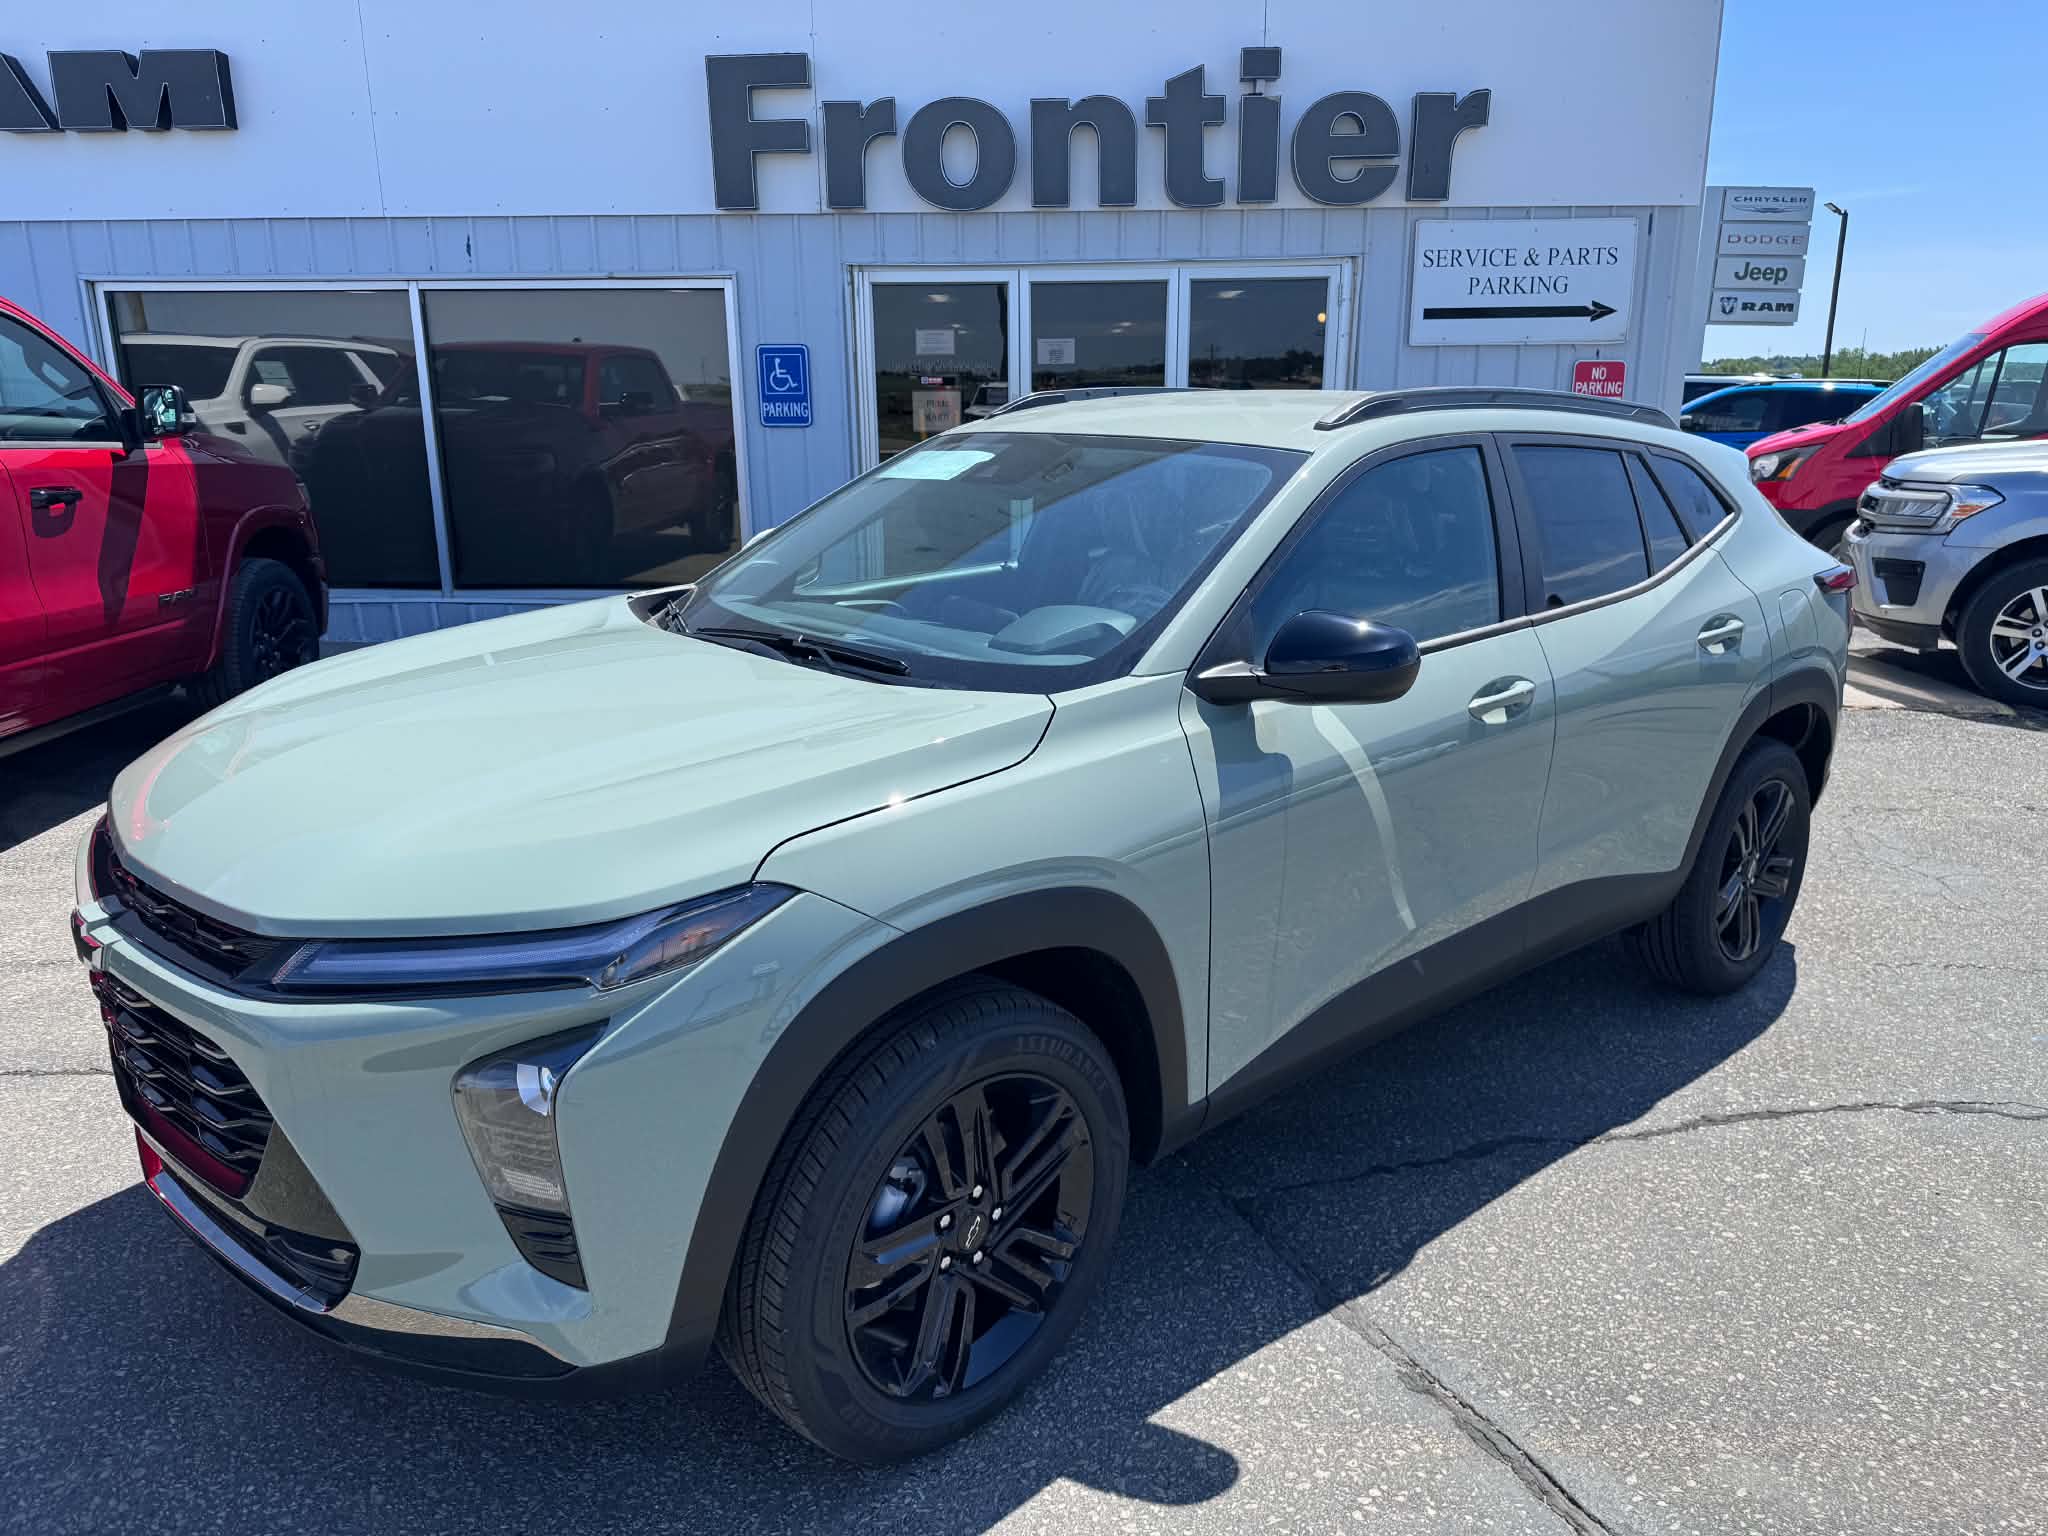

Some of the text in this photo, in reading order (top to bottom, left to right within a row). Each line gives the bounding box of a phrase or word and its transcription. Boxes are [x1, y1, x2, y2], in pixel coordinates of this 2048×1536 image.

[705, 47, 1492, 211] Frontier
[1727, 234, 1804, 245] DODGE
[1423, 247, 1619, 267] SERVICE & PARTS
[1733, 261, 1788, 285] Jeep
[1467, 275, 1569, 295] PARKING
[1741, 302, 1794, 312] RAM
[1591, 367, 1607, 380] NO
[1575, 381, 1623, 395] PARKING
[763, 402, 809, 417] PARKING
